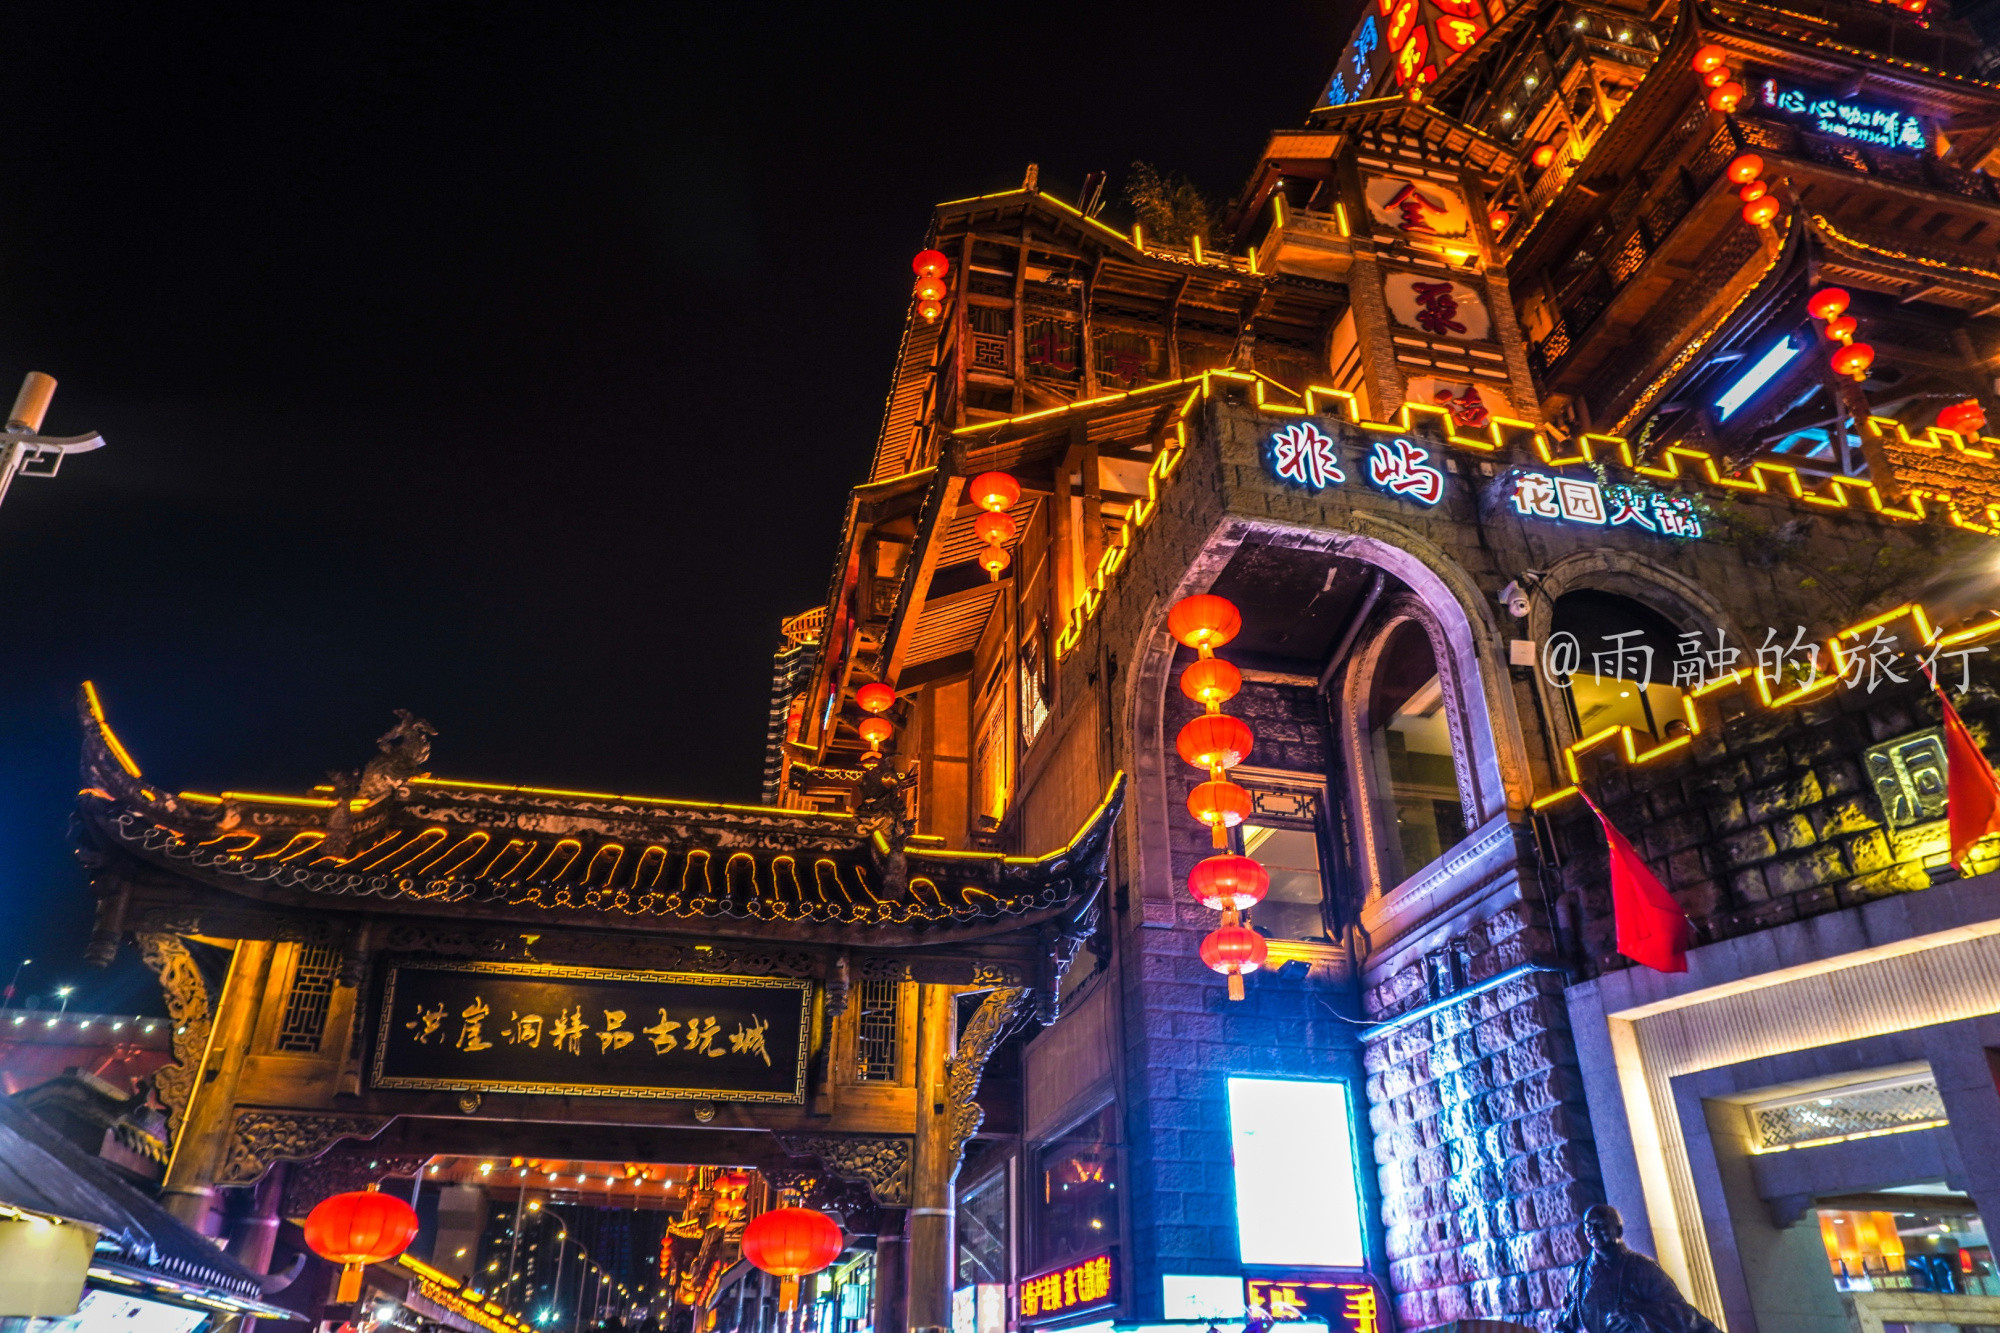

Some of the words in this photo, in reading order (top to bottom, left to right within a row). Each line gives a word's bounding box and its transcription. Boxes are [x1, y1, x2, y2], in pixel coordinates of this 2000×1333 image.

[1512, 470, 1703, 539] 花园火锅
[405, 995, 772, 1068] 洪崖洞精品古玩城
